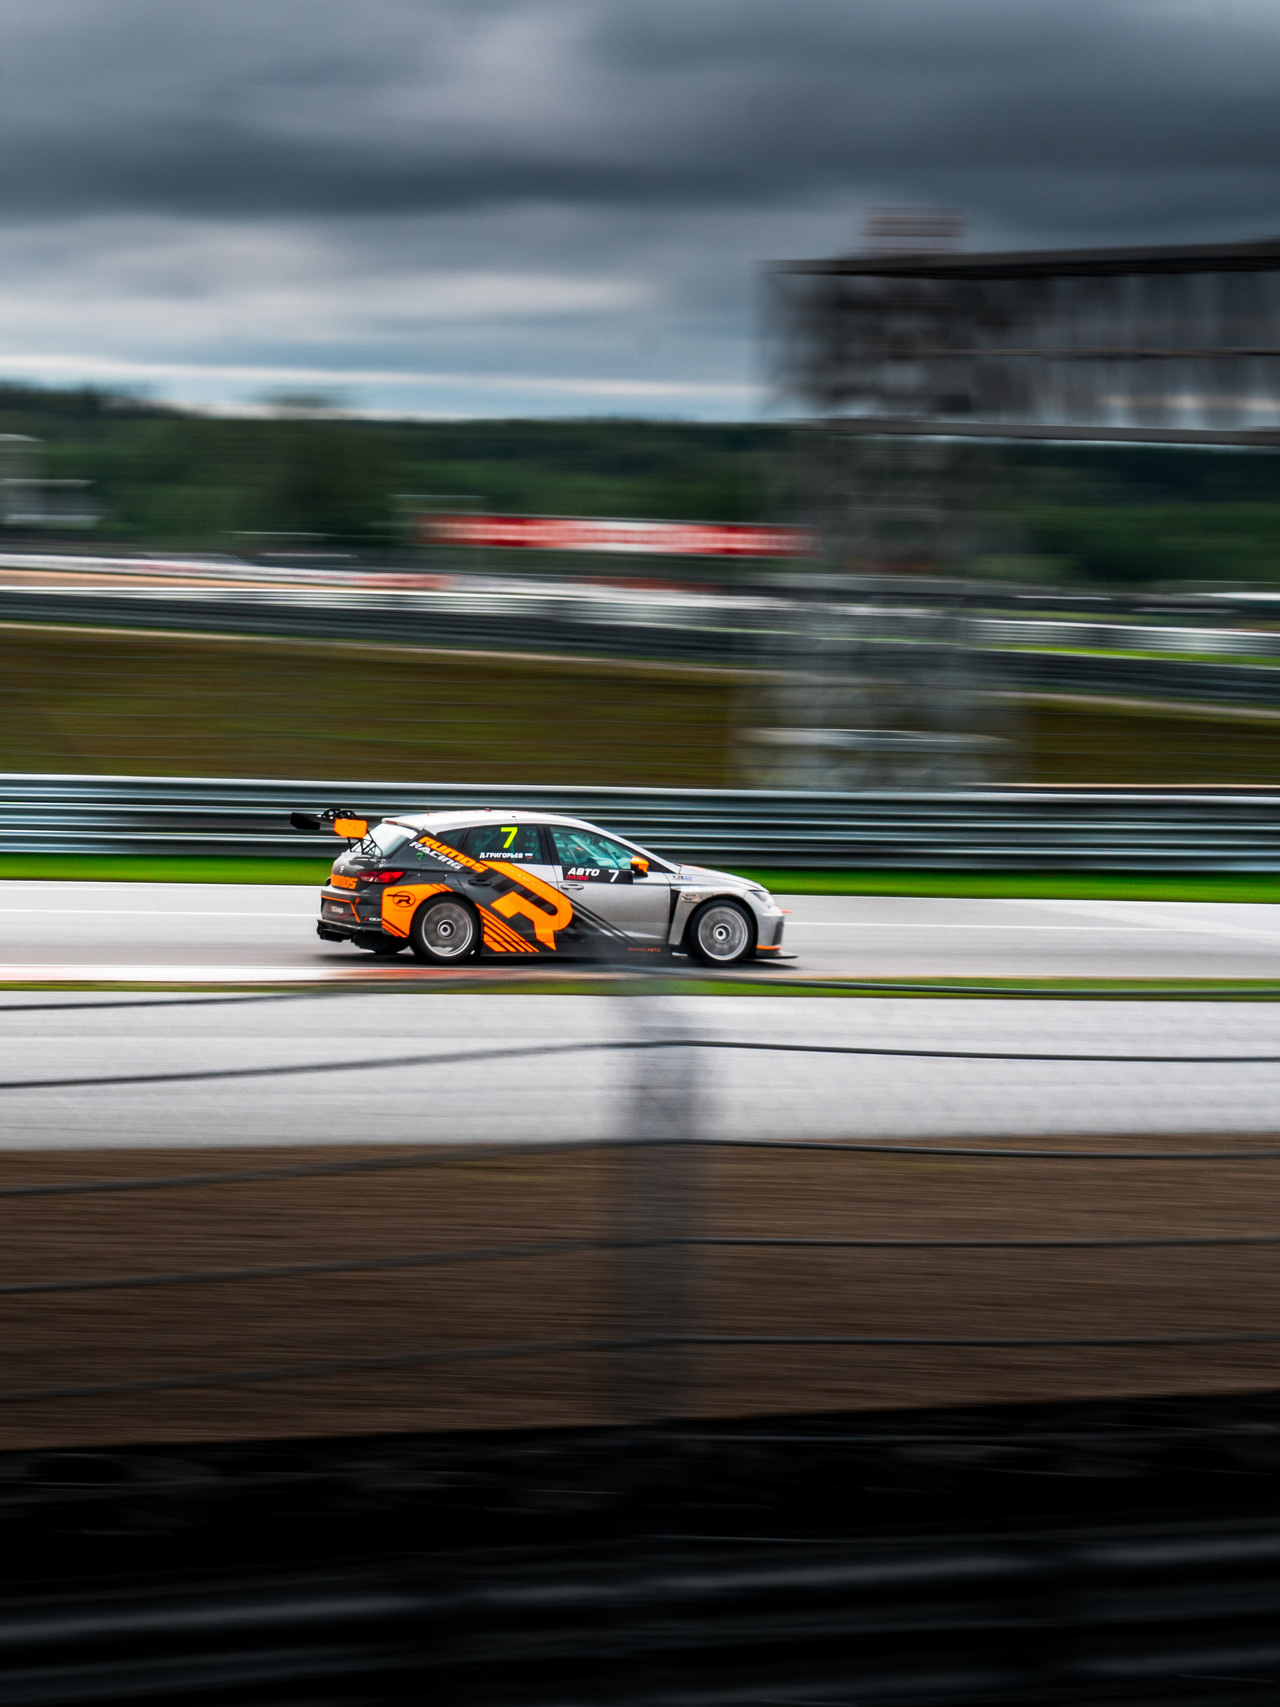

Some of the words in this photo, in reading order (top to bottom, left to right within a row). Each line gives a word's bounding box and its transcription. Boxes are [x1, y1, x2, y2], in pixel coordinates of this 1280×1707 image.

[500, 826, 518, 849] 7
[418, 835, 489, 874] RUMOS
[567, 867, 600, 876] АВТО
[608, 869, 620, 883] 7
